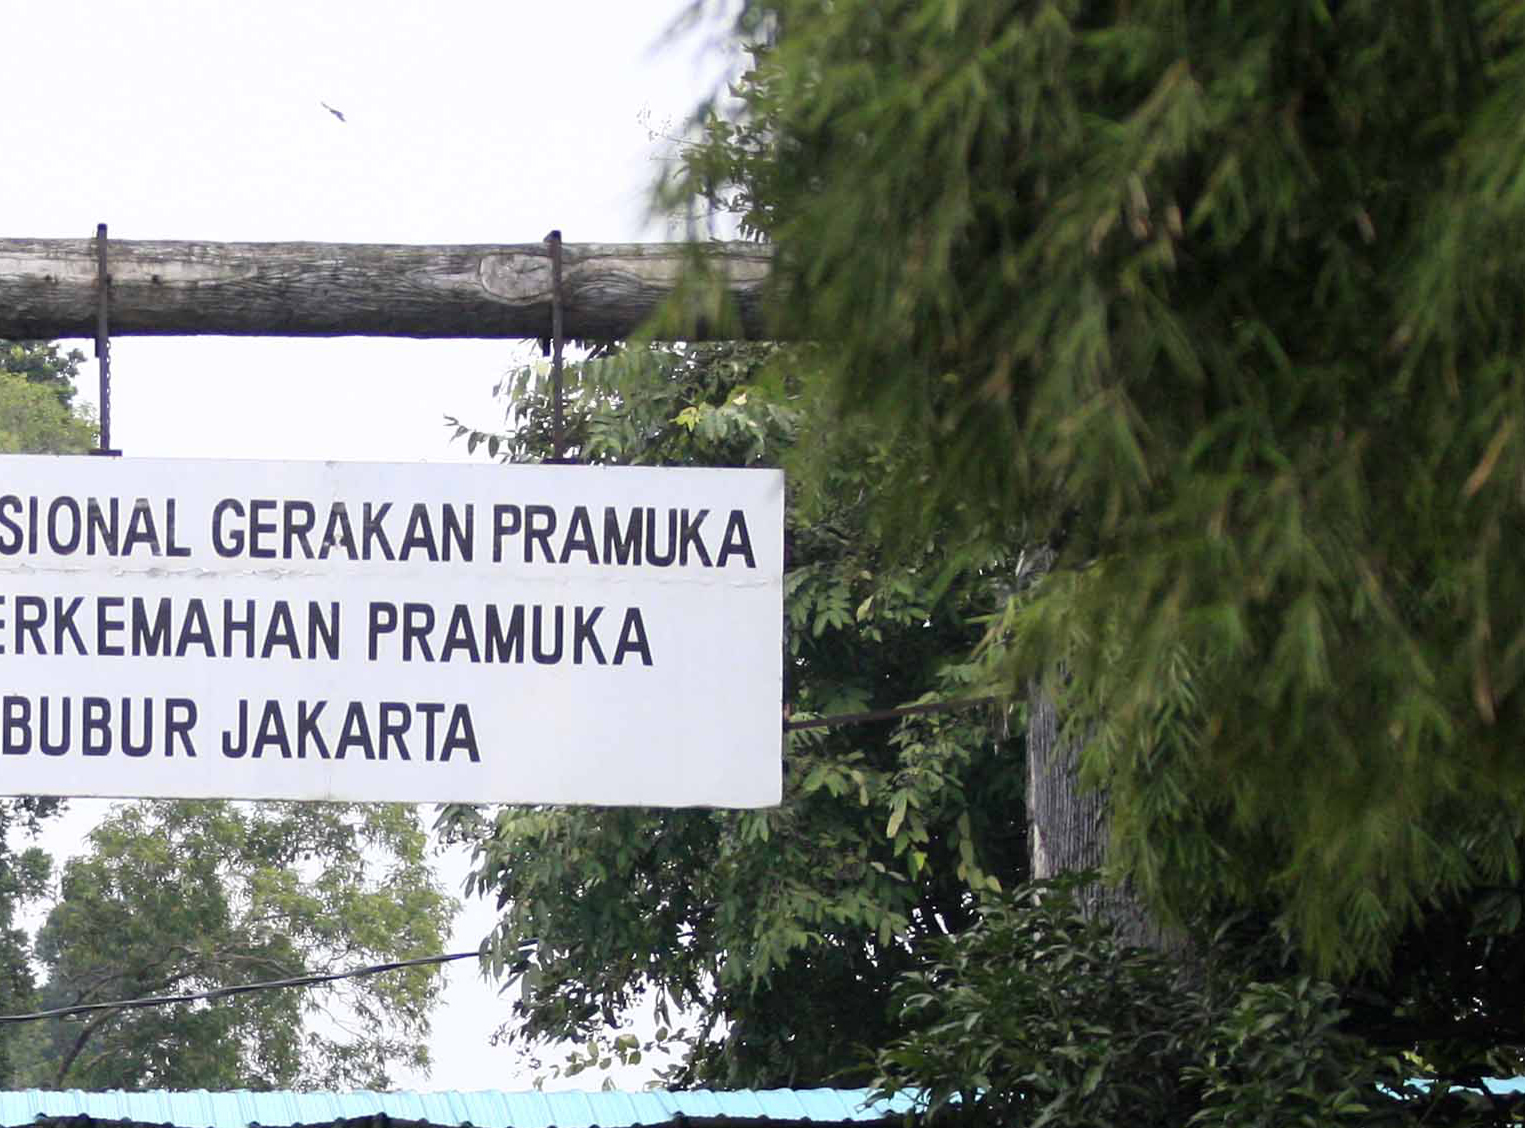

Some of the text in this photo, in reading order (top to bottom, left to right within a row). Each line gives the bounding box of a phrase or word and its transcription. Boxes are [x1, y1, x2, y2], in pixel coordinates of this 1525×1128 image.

[212, 498, 474, 562] GERAKAN
[493, 504, 756, 569] PRAMUKA
[368, 602, 653, 666] PRAMUKA
[222, 699, 480, 762] JAKARTA
